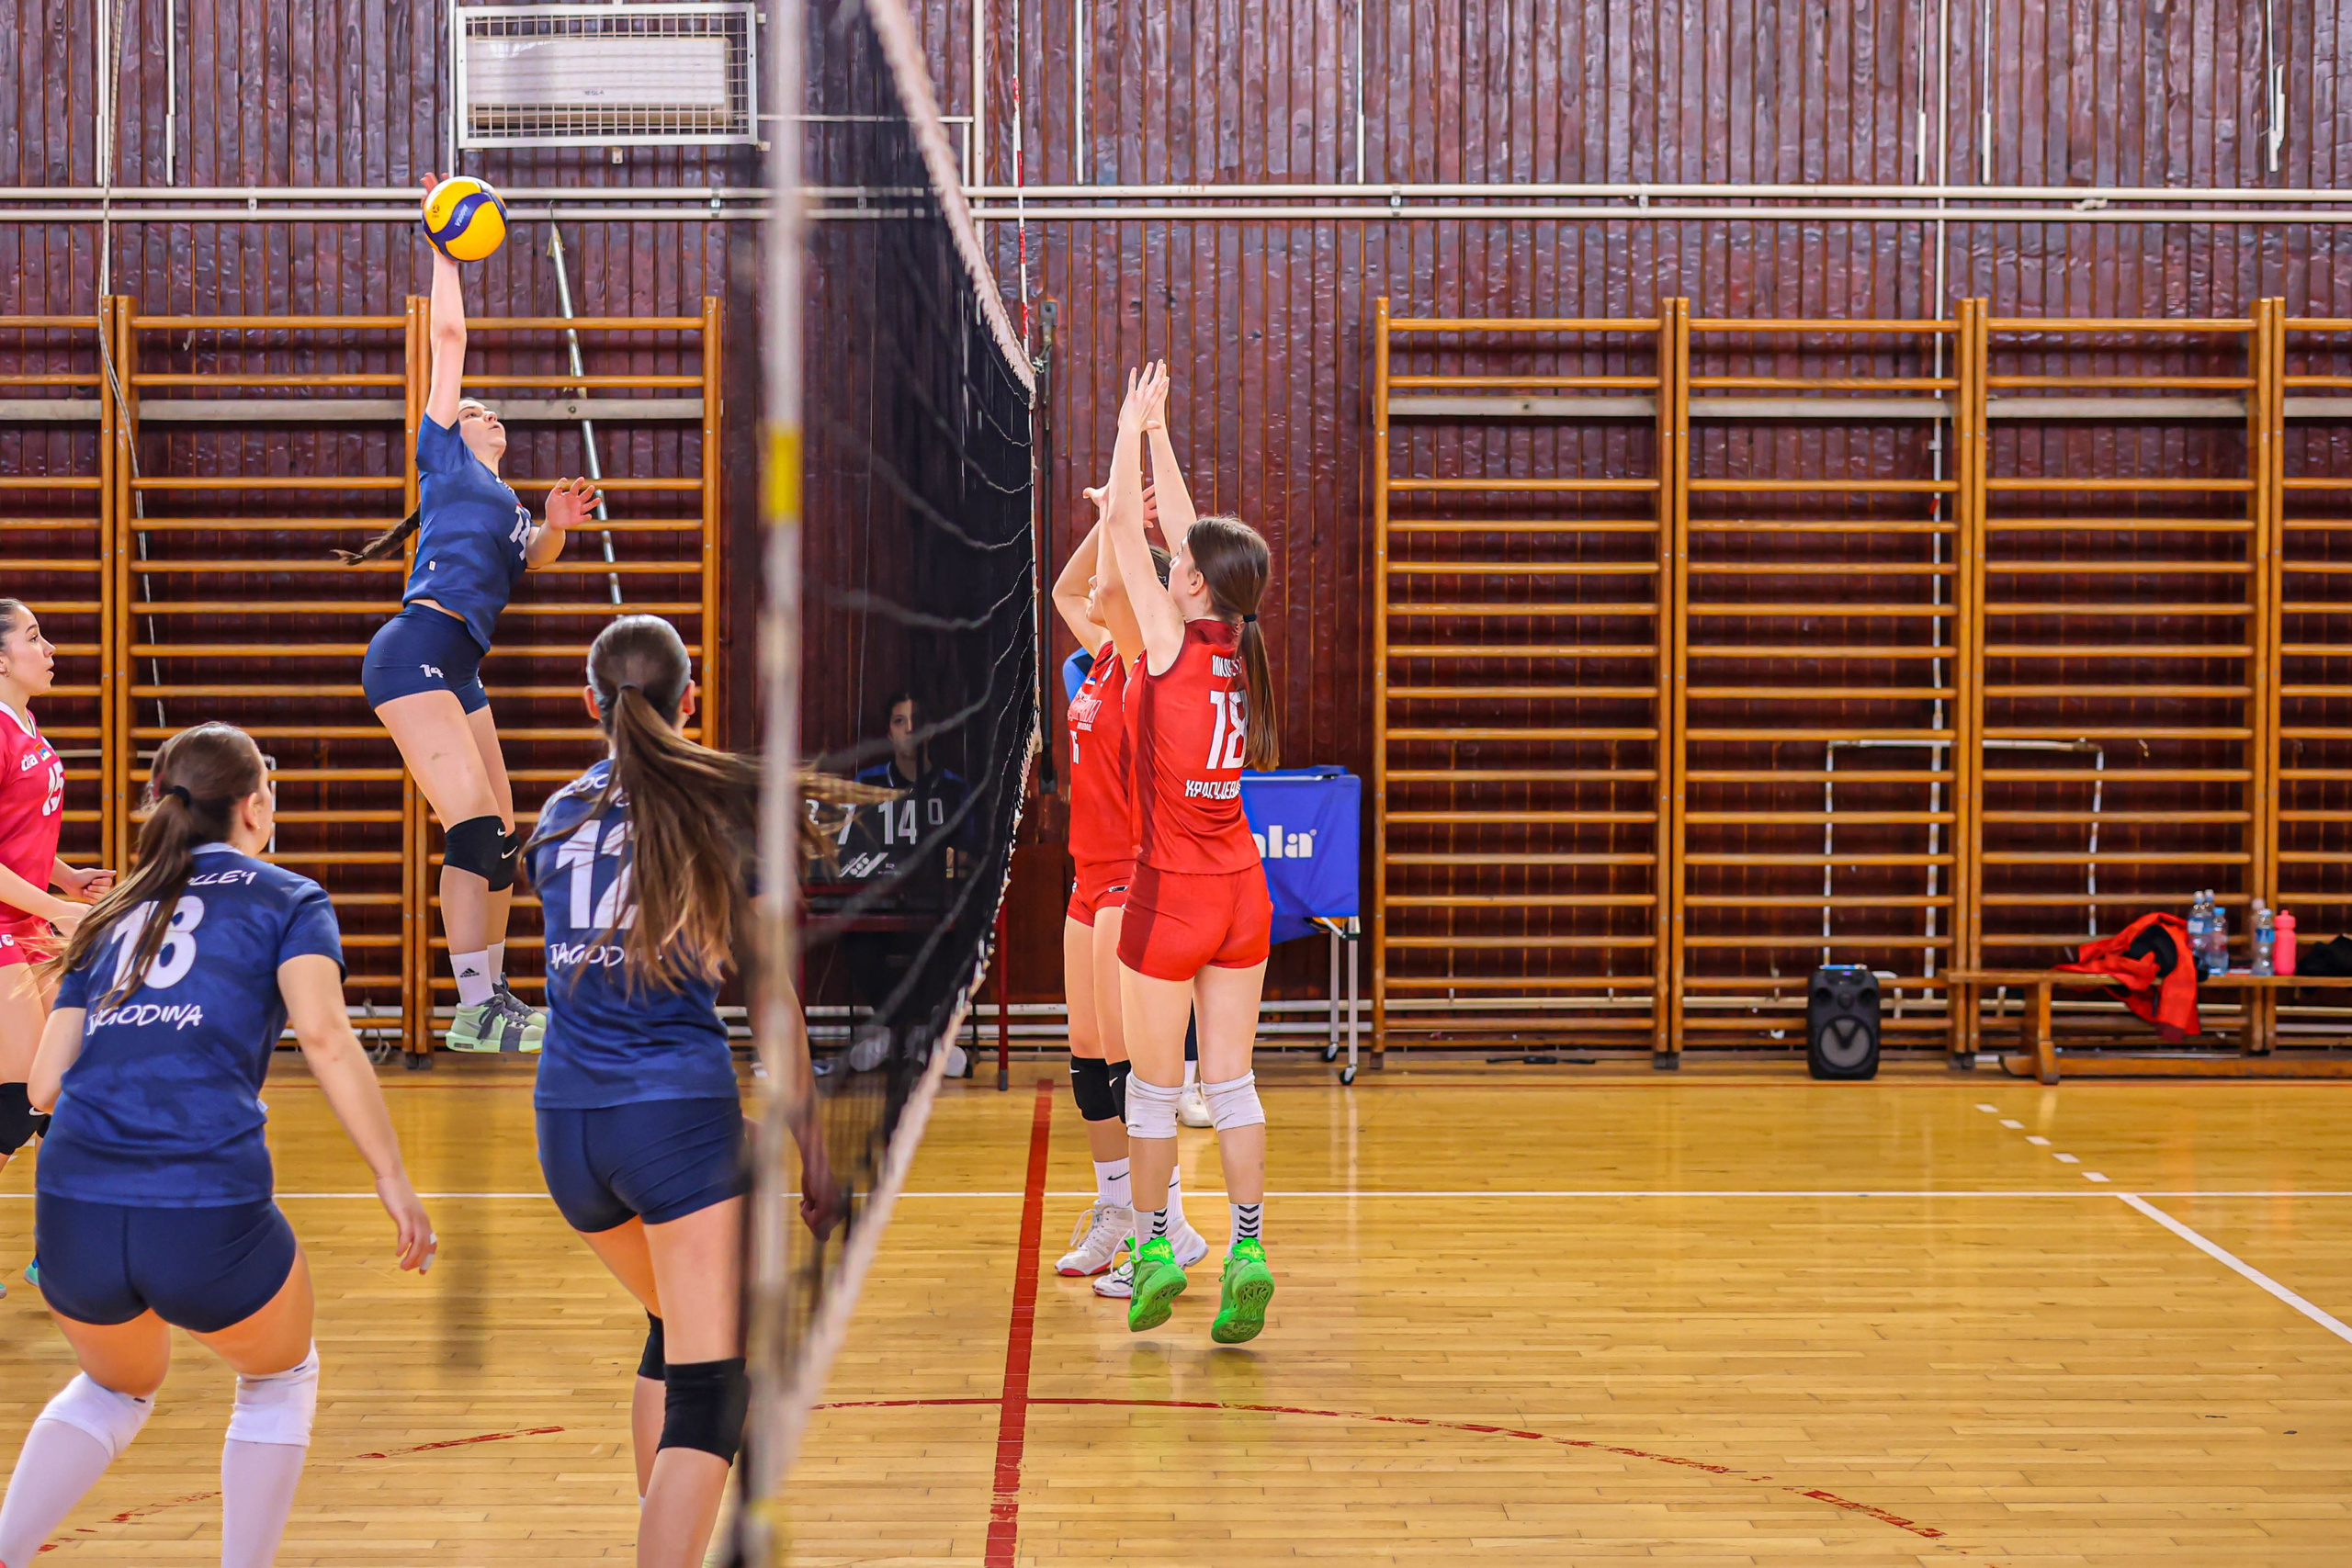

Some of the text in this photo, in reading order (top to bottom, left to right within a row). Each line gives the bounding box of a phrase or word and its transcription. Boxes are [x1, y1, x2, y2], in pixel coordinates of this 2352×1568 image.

[1205, 690, 1250, 770] 18
[42, 761, 65, 817] 15
[877, 799, 918, 845] 14
[187, 869, 257, 886] LLEY
[111, 895, 205, 991] 18
[548, 942, 628, 970] JAGOD
